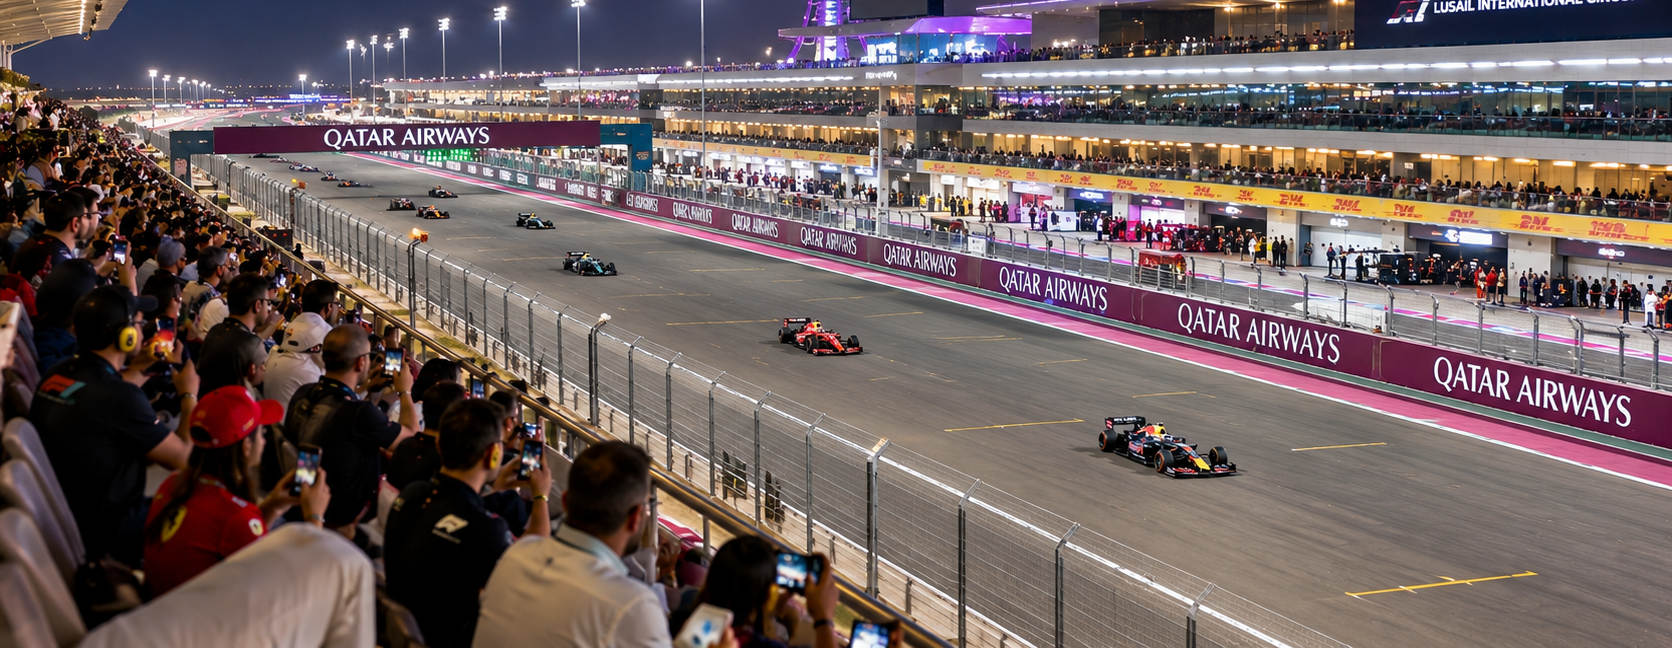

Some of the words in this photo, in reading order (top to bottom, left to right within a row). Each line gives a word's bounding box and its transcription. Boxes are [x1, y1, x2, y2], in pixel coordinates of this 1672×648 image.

[1433, 0, 1475, 13] LUSAIL
[323, 128, 396, 150] QATAR
[401, 126, 490, 147] AIRWAYS
[883, 243, 912, 268] QATAR
[913, 250, 957, 277] AIRWAYS
[999, 266, 1041, 295] QATAR
[1044, 275, 1108, 311] AIRWAYS
[1177, 302, 1241, 341] QATAR
[1246, 318, 1341, 364] AIRWAYS
[1433, 356, 1511, 400] QATAR
[1516, 375, 1632, 427] AIRWAYS
